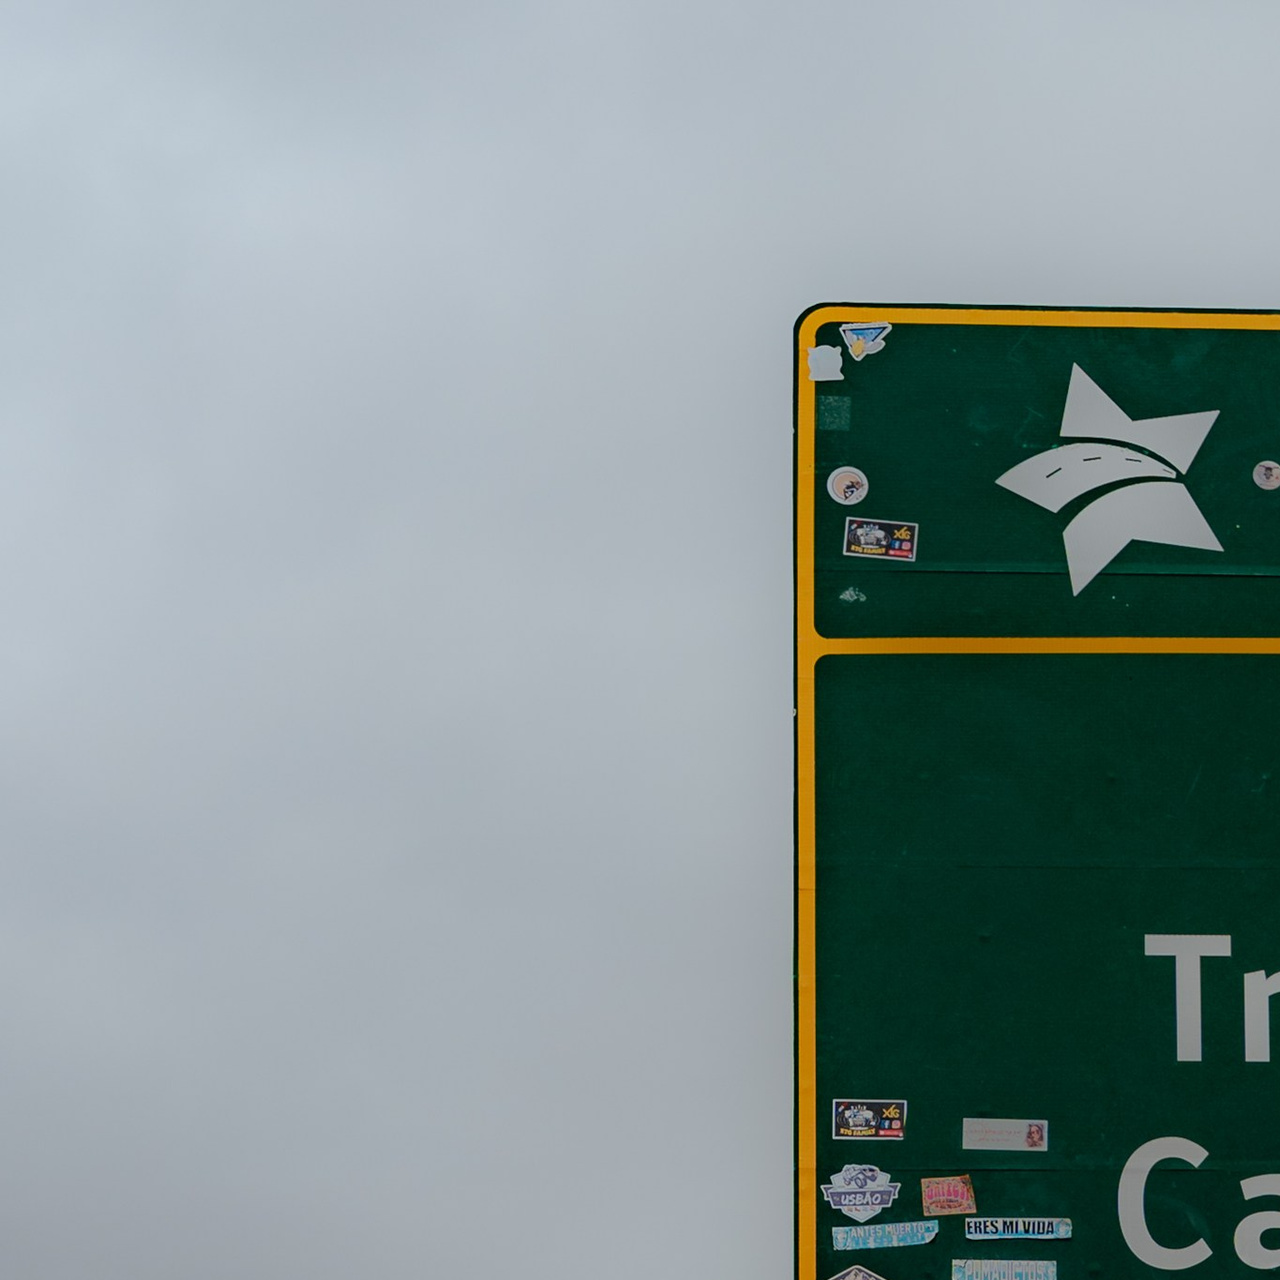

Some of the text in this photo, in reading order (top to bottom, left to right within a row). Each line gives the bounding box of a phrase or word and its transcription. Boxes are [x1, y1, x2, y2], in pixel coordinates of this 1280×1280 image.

[967, 1221, 1054, 1235] ERES MI VIDA
